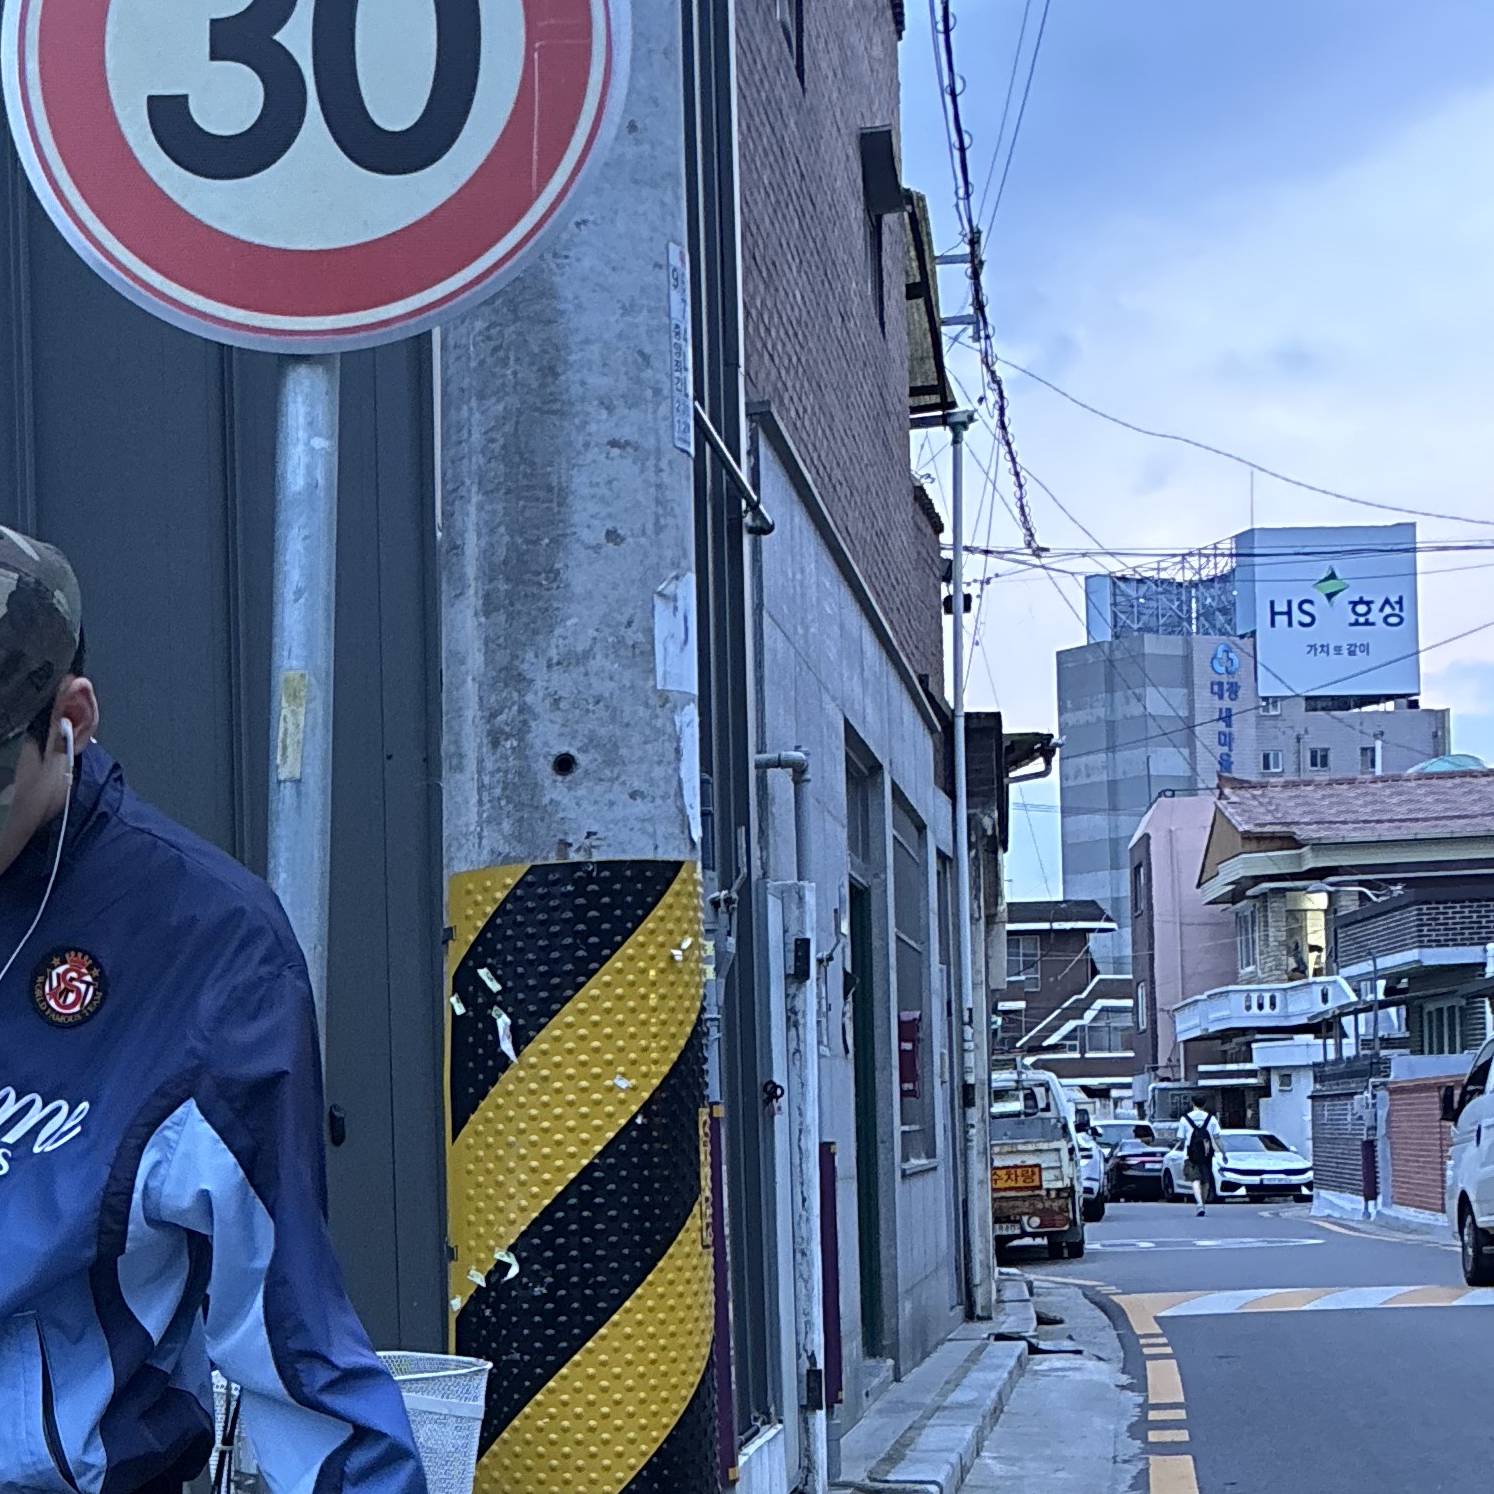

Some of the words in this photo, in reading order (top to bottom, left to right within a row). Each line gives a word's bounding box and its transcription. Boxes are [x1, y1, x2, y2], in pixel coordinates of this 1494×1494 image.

[146, 0, 482, 180] 30
[1269, 598, 1317, 628] HS
[1348, 595, 1405, 628] 효성
[1306, 643, 1330, 657] 가치
